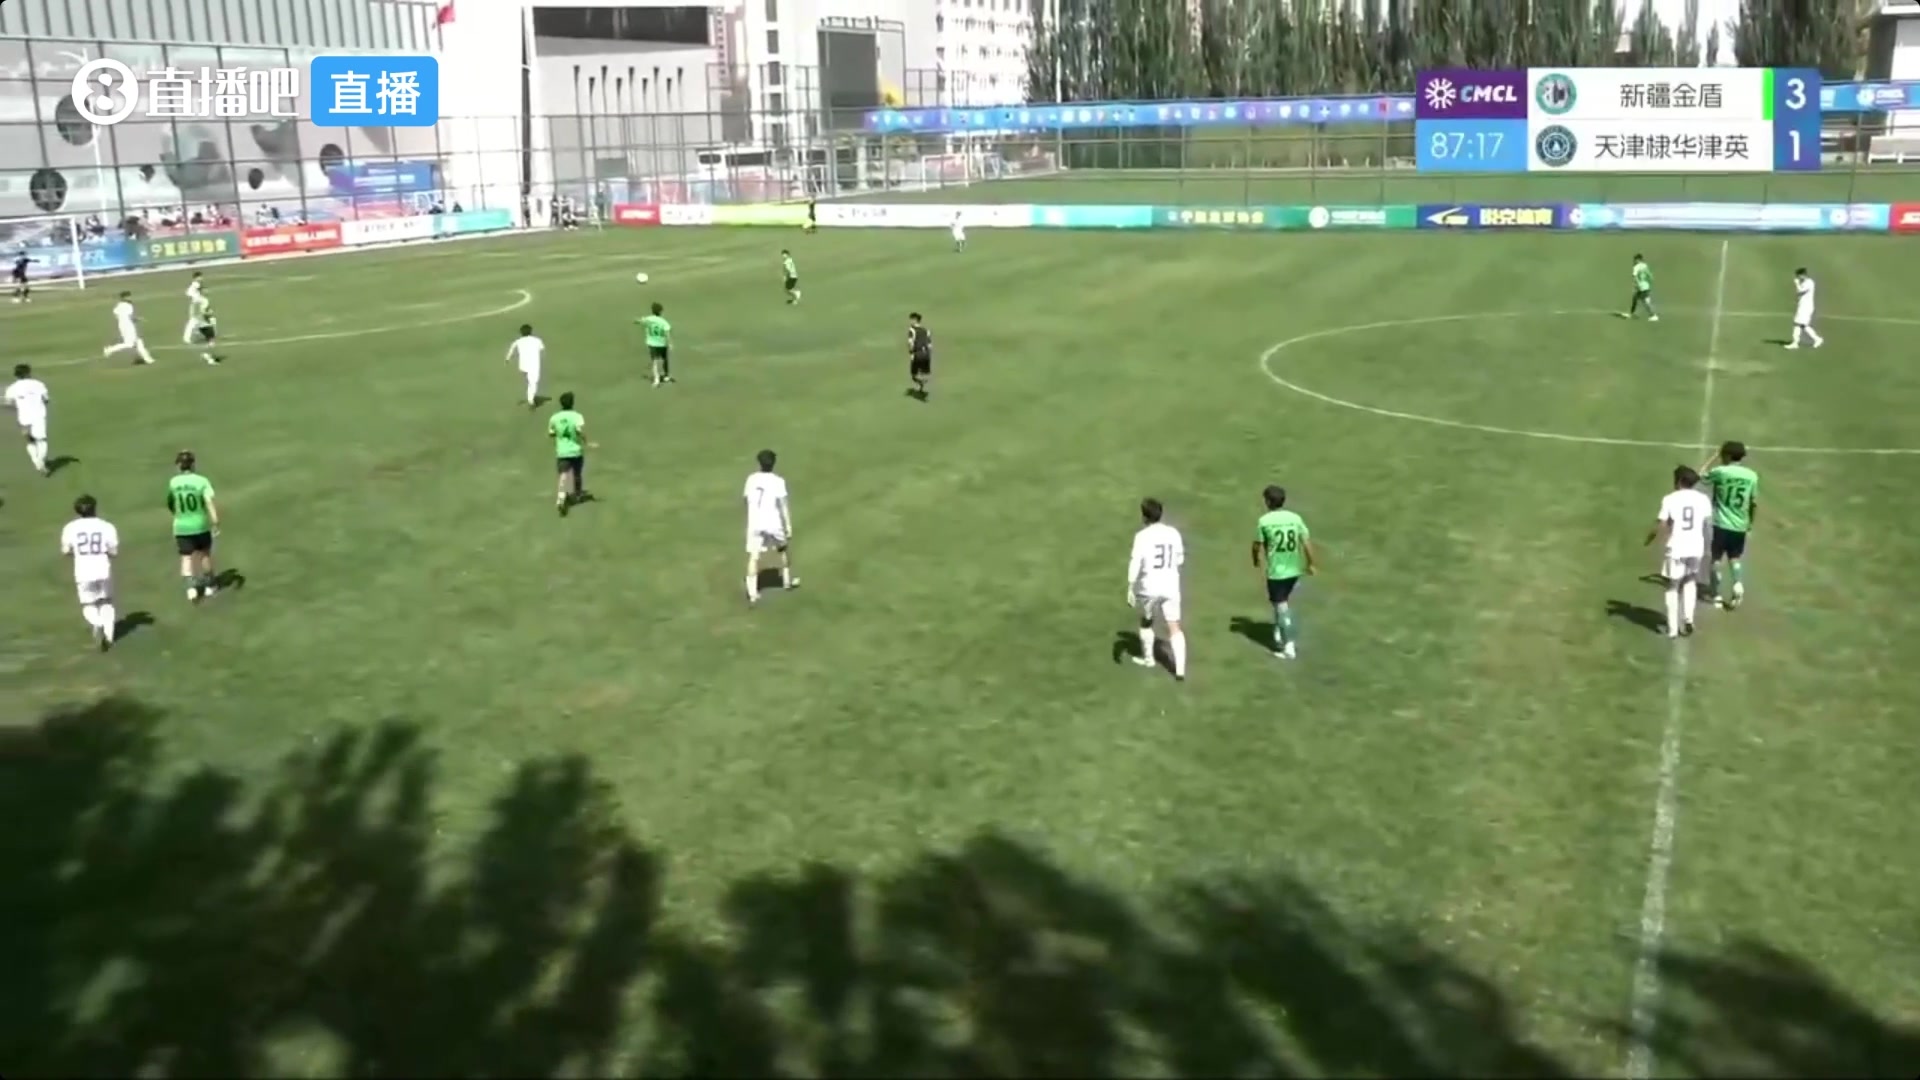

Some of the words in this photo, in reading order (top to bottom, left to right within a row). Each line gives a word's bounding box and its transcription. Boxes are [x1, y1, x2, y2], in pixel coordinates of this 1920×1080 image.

[179, 493, 198, 513] 10
[755, 487, 765, 508] 7
[1725, 486, 1746, 509] 15
[1682, 507, 1694, 531] 9
[77, 532, 103, 555] 28
[1274, 529, 1297, 552] 28
[1153, 544, 1173, 569] 31
